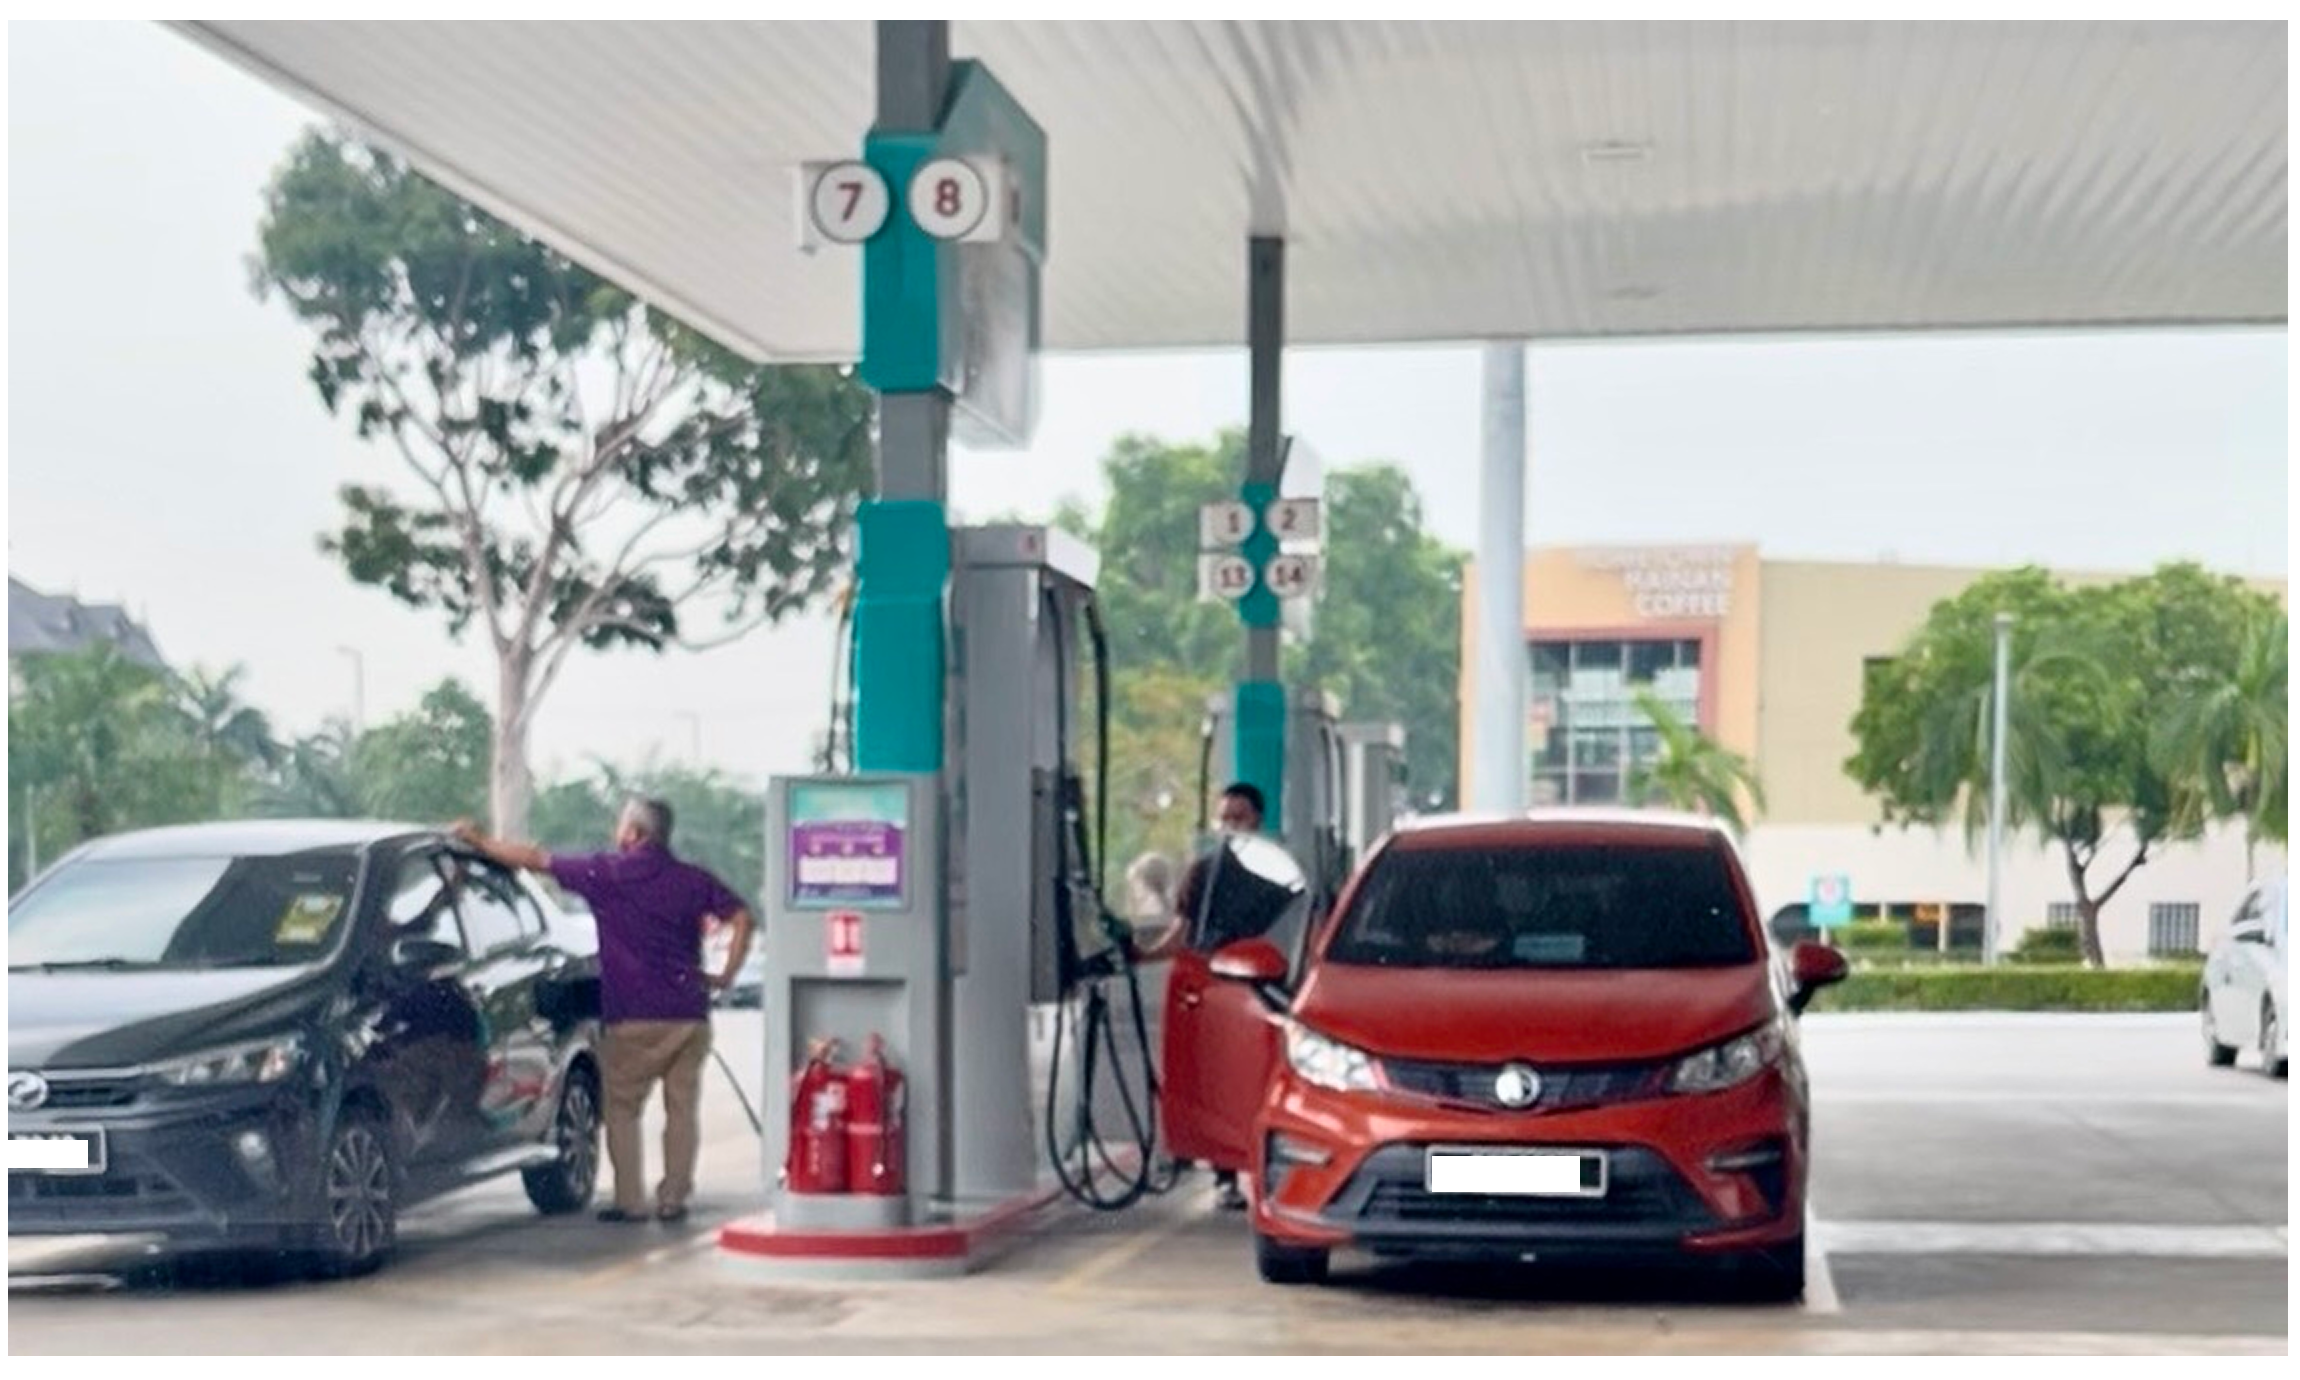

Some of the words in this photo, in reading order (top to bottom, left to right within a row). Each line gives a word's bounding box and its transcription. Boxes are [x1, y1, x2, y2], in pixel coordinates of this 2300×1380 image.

[837, 182, 863, 222] 7
[934, 178, 962, 217] 8
[1228, 512, 1240, 533] 1
[1282, 507, 1297, 531] 2
[1222, 564, 1247, 588] 13
[1276, 564, 1302, 587] 14
[1634, 592, 1732, 617] COFFEE
